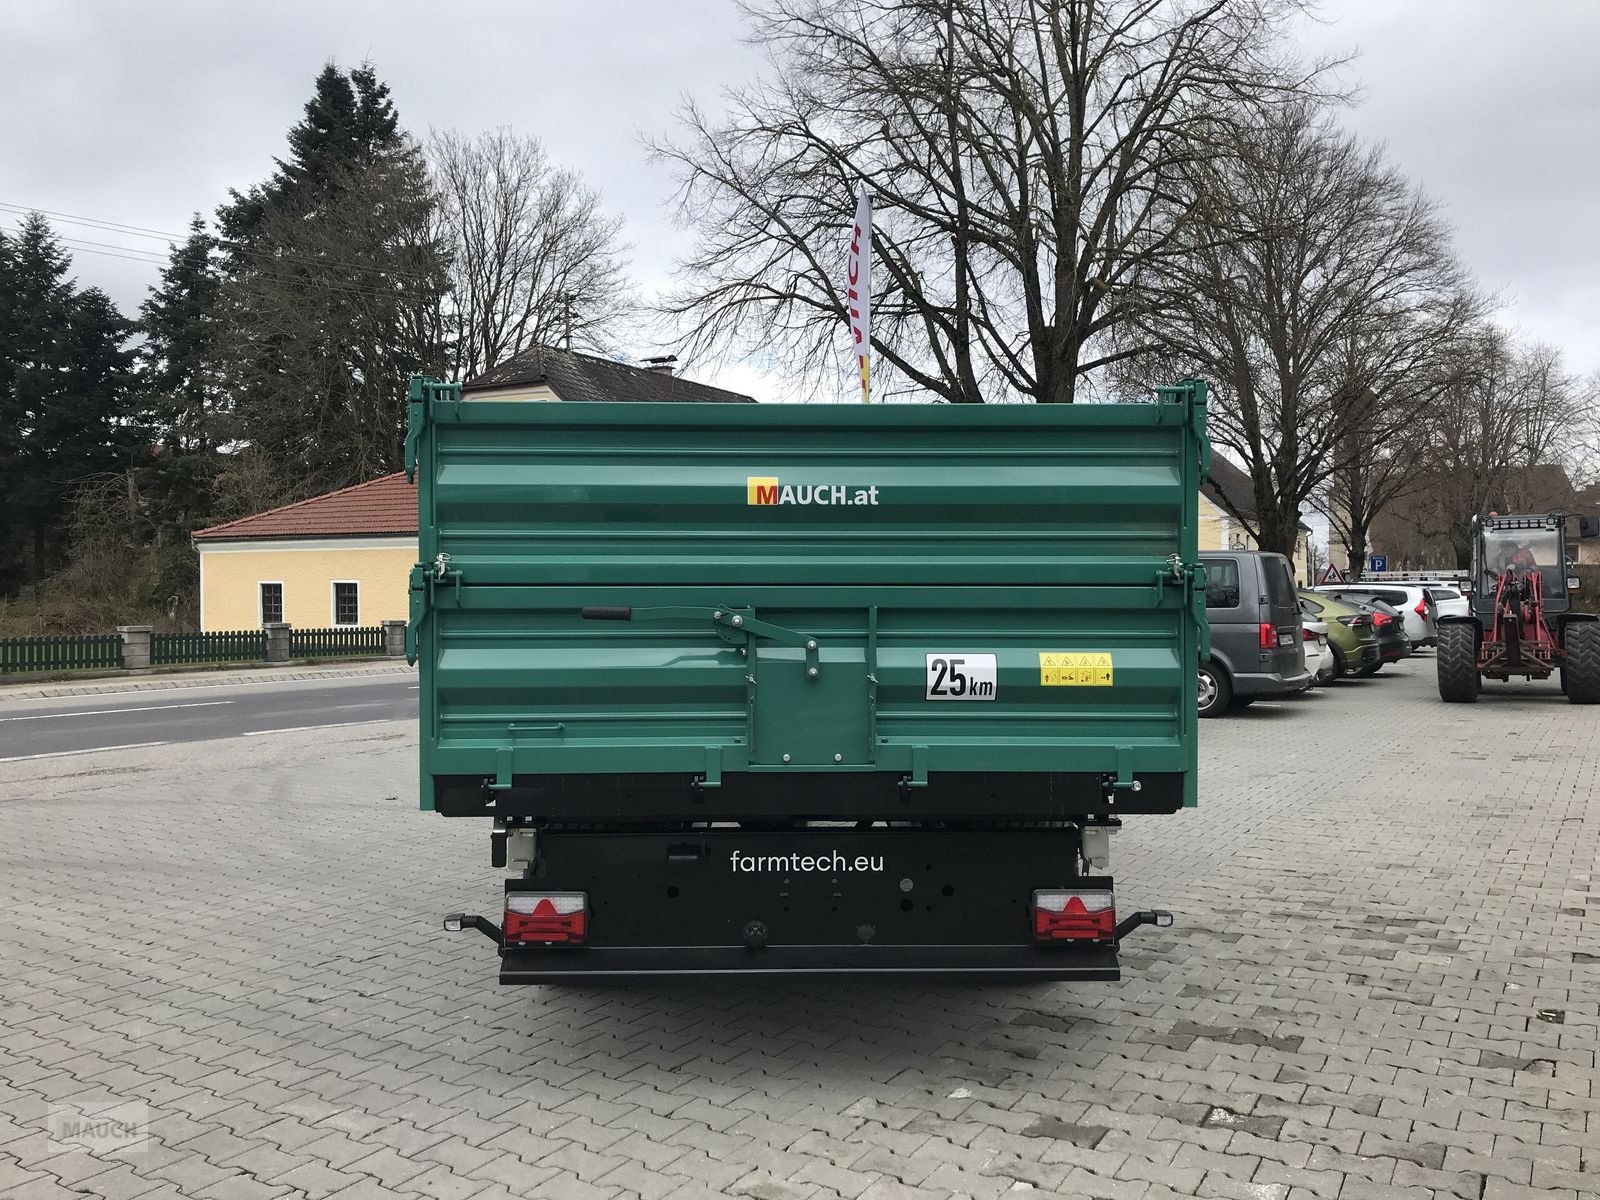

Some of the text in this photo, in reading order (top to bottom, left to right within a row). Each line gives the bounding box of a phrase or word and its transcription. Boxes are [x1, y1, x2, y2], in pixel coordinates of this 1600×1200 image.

[757, 485, 879, 505] MAUCH.at
[1375, 560, 1383, 570] P
[930, 658, 993, 696] 25 km
[730, 850, 884, 872] farmtech.eu
